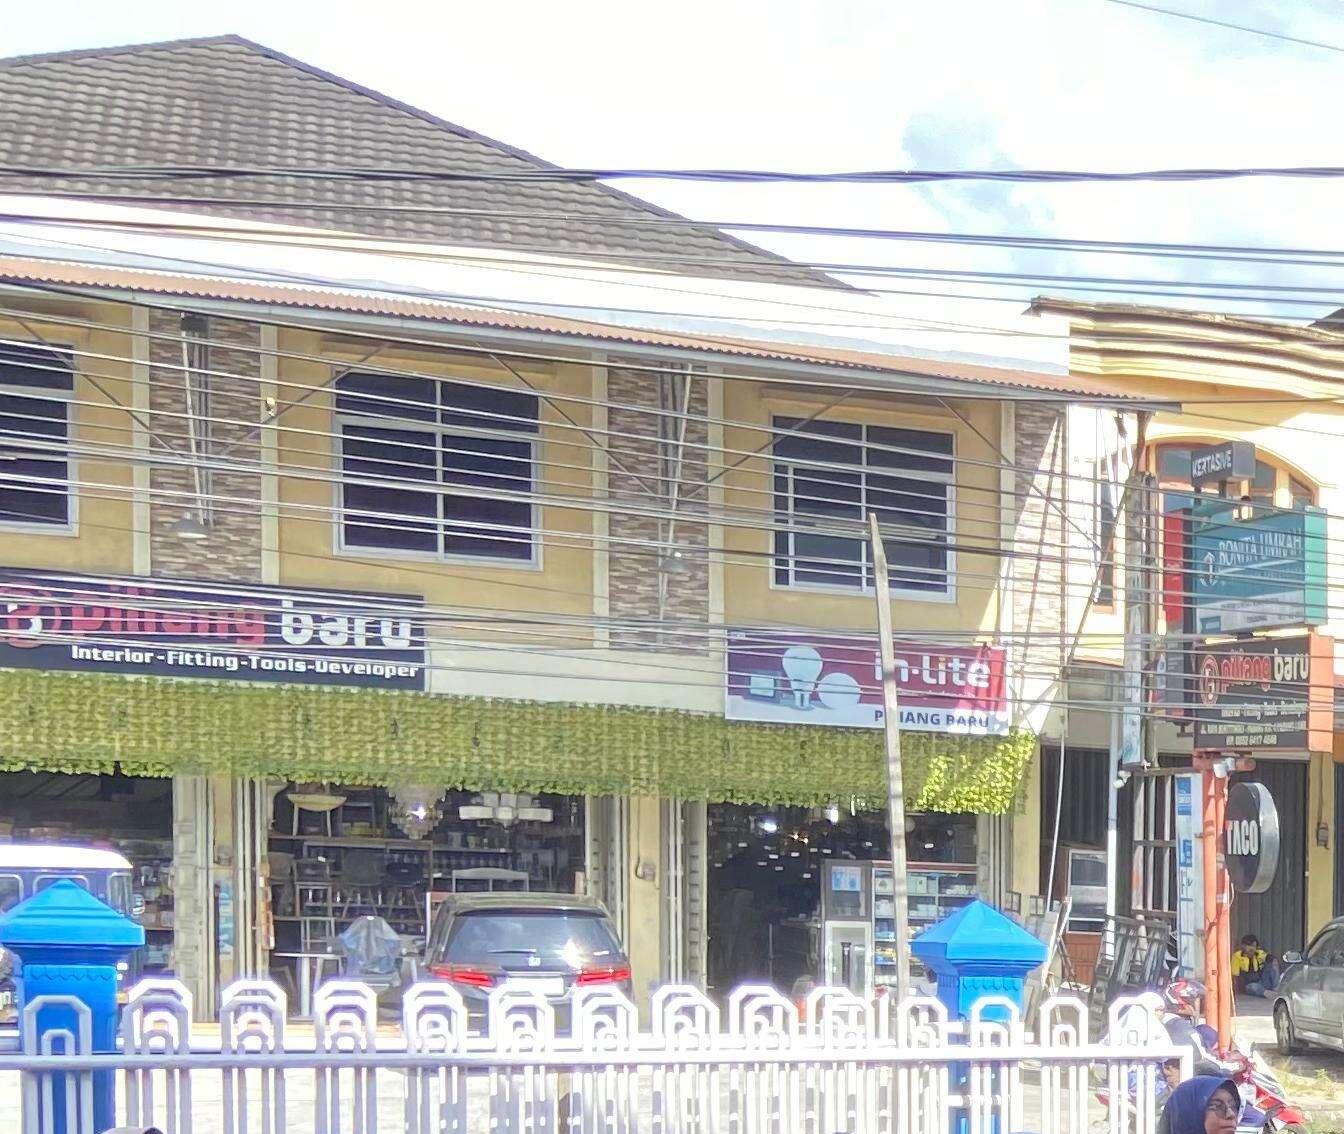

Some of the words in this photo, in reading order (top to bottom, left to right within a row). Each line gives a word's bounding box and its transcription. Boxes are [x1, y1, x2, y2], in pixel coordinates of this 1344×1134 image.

[281, 599, 412, 648] baru
[1274, 648, 1309, 681] baru
[946, 714, 990, 729] BARU
[1226, 820, 1259, 856] TACO
